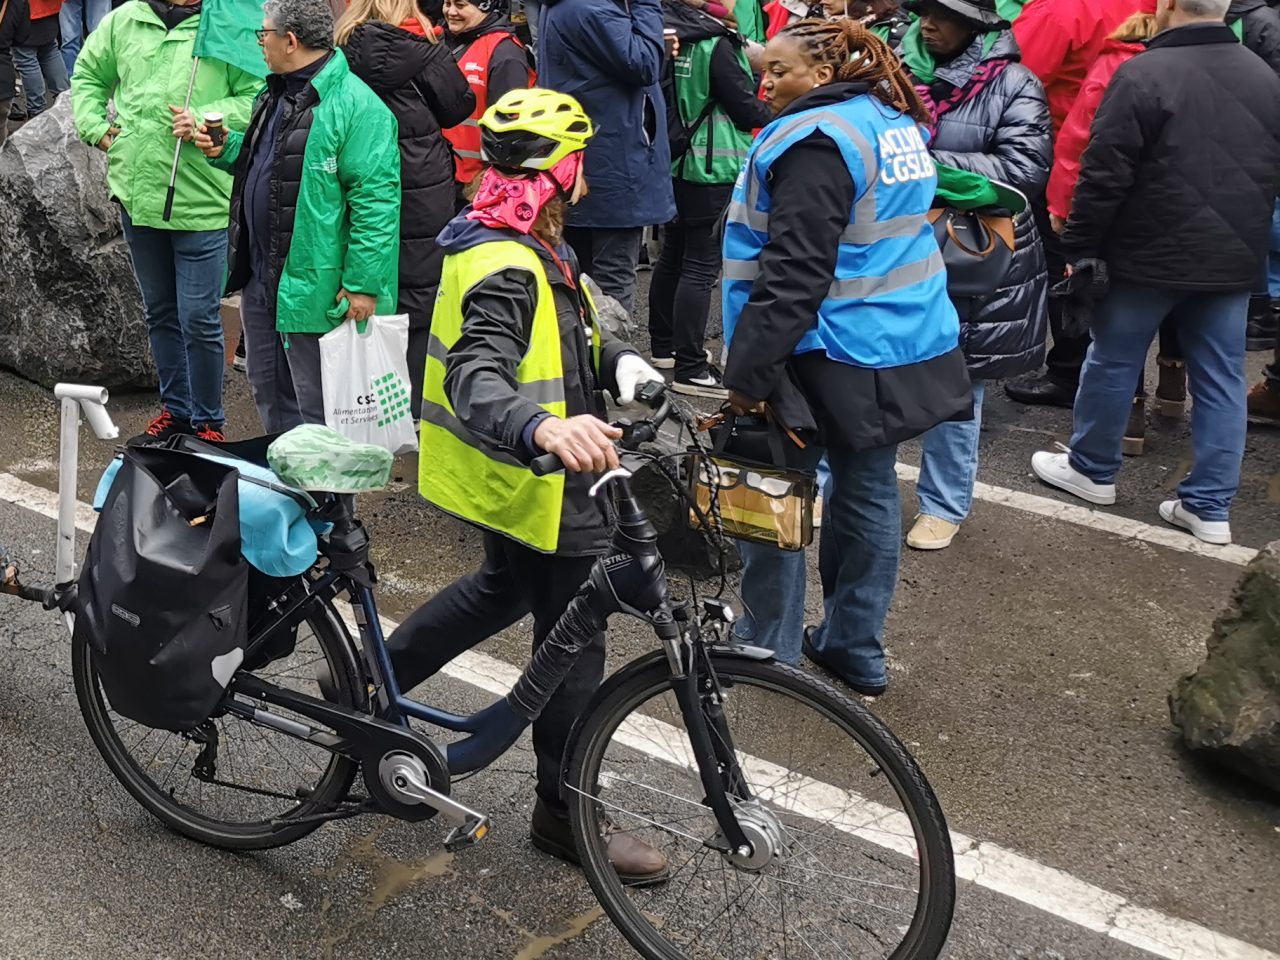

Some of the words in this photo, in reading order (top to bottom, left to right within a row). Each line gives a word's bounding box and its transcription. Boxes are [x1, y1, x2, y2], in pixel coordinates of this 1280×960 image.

[879, 126, 927, 158] ACLVB
[880, 155, 934, 185] CGSLB
[333, 405, 378, 416] Alimentation
[351, 414, 378, 425] Services
